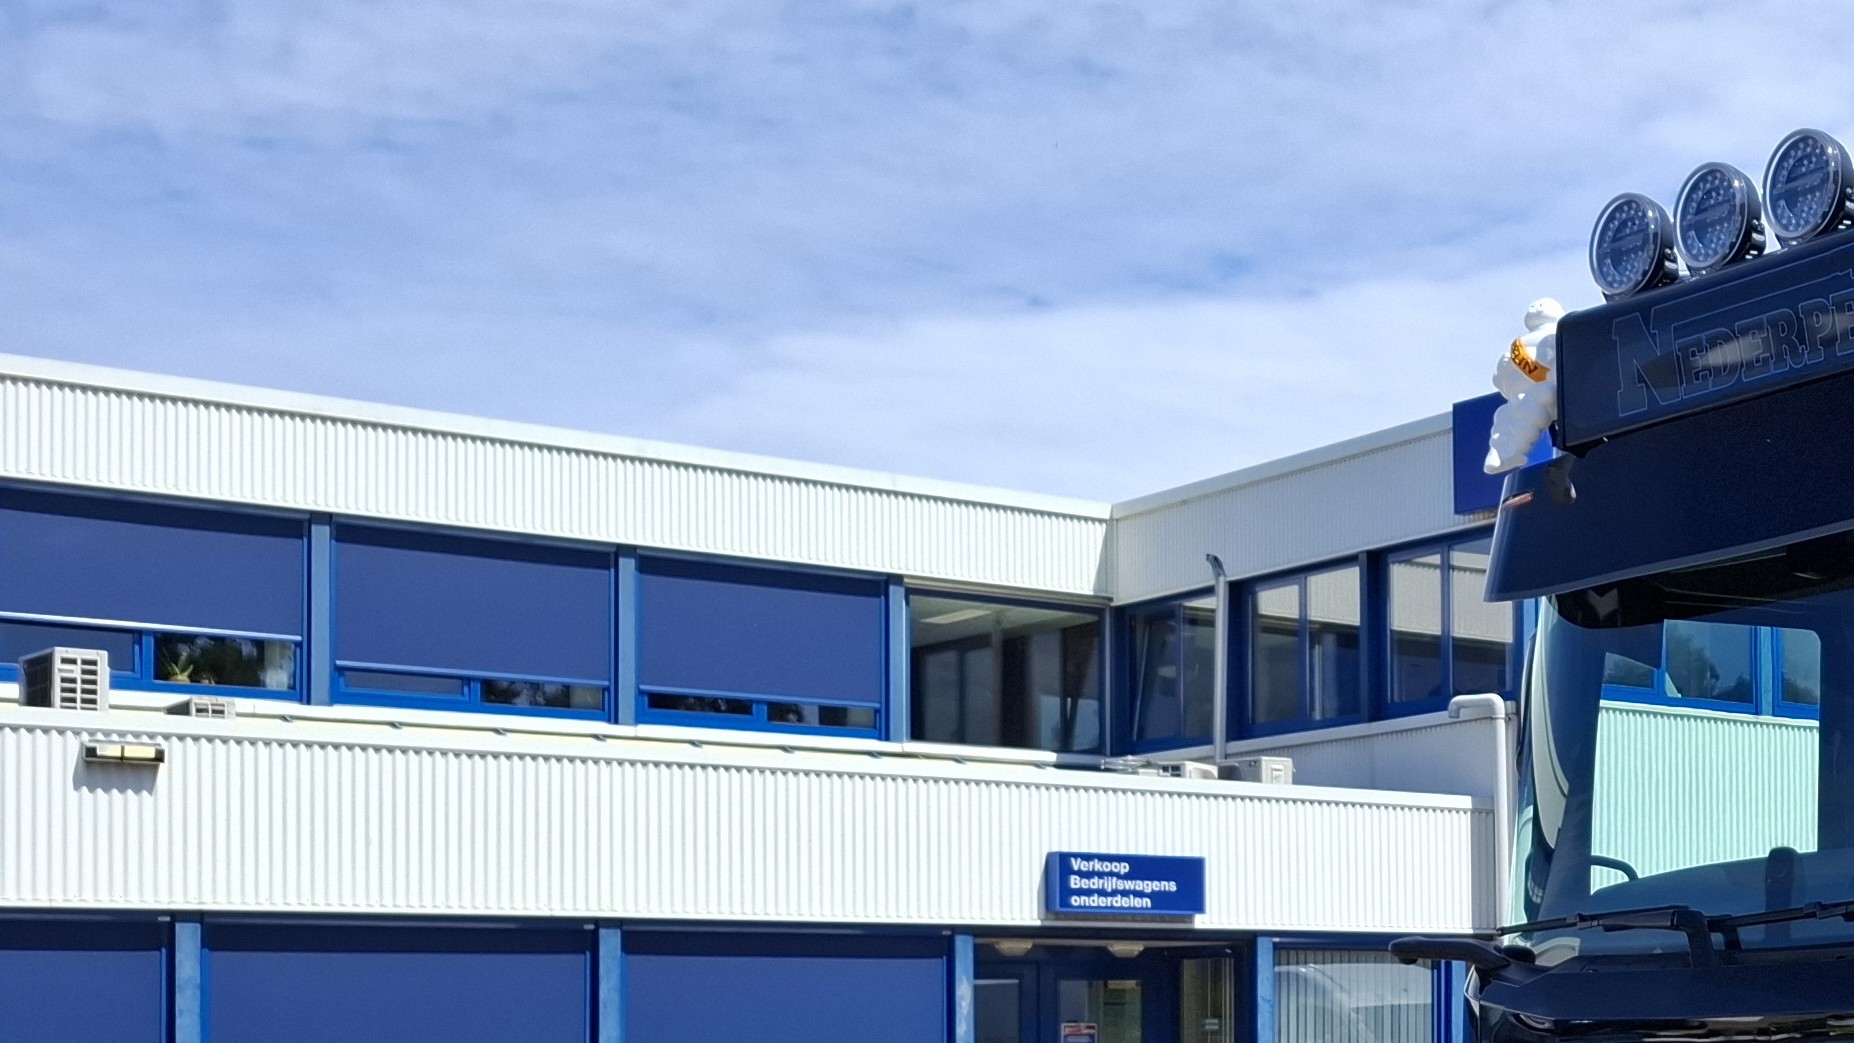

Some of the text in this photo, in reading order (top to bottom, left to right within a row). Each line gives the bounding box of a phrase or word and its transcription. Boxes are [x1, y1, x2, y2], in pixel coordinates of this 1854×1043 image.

[1070, 857, 1129, 875] Verkoop
[1070, 875, 1177, 892] Bedrijfswagens
[1071, 893, 1151, 908] onderdelen
